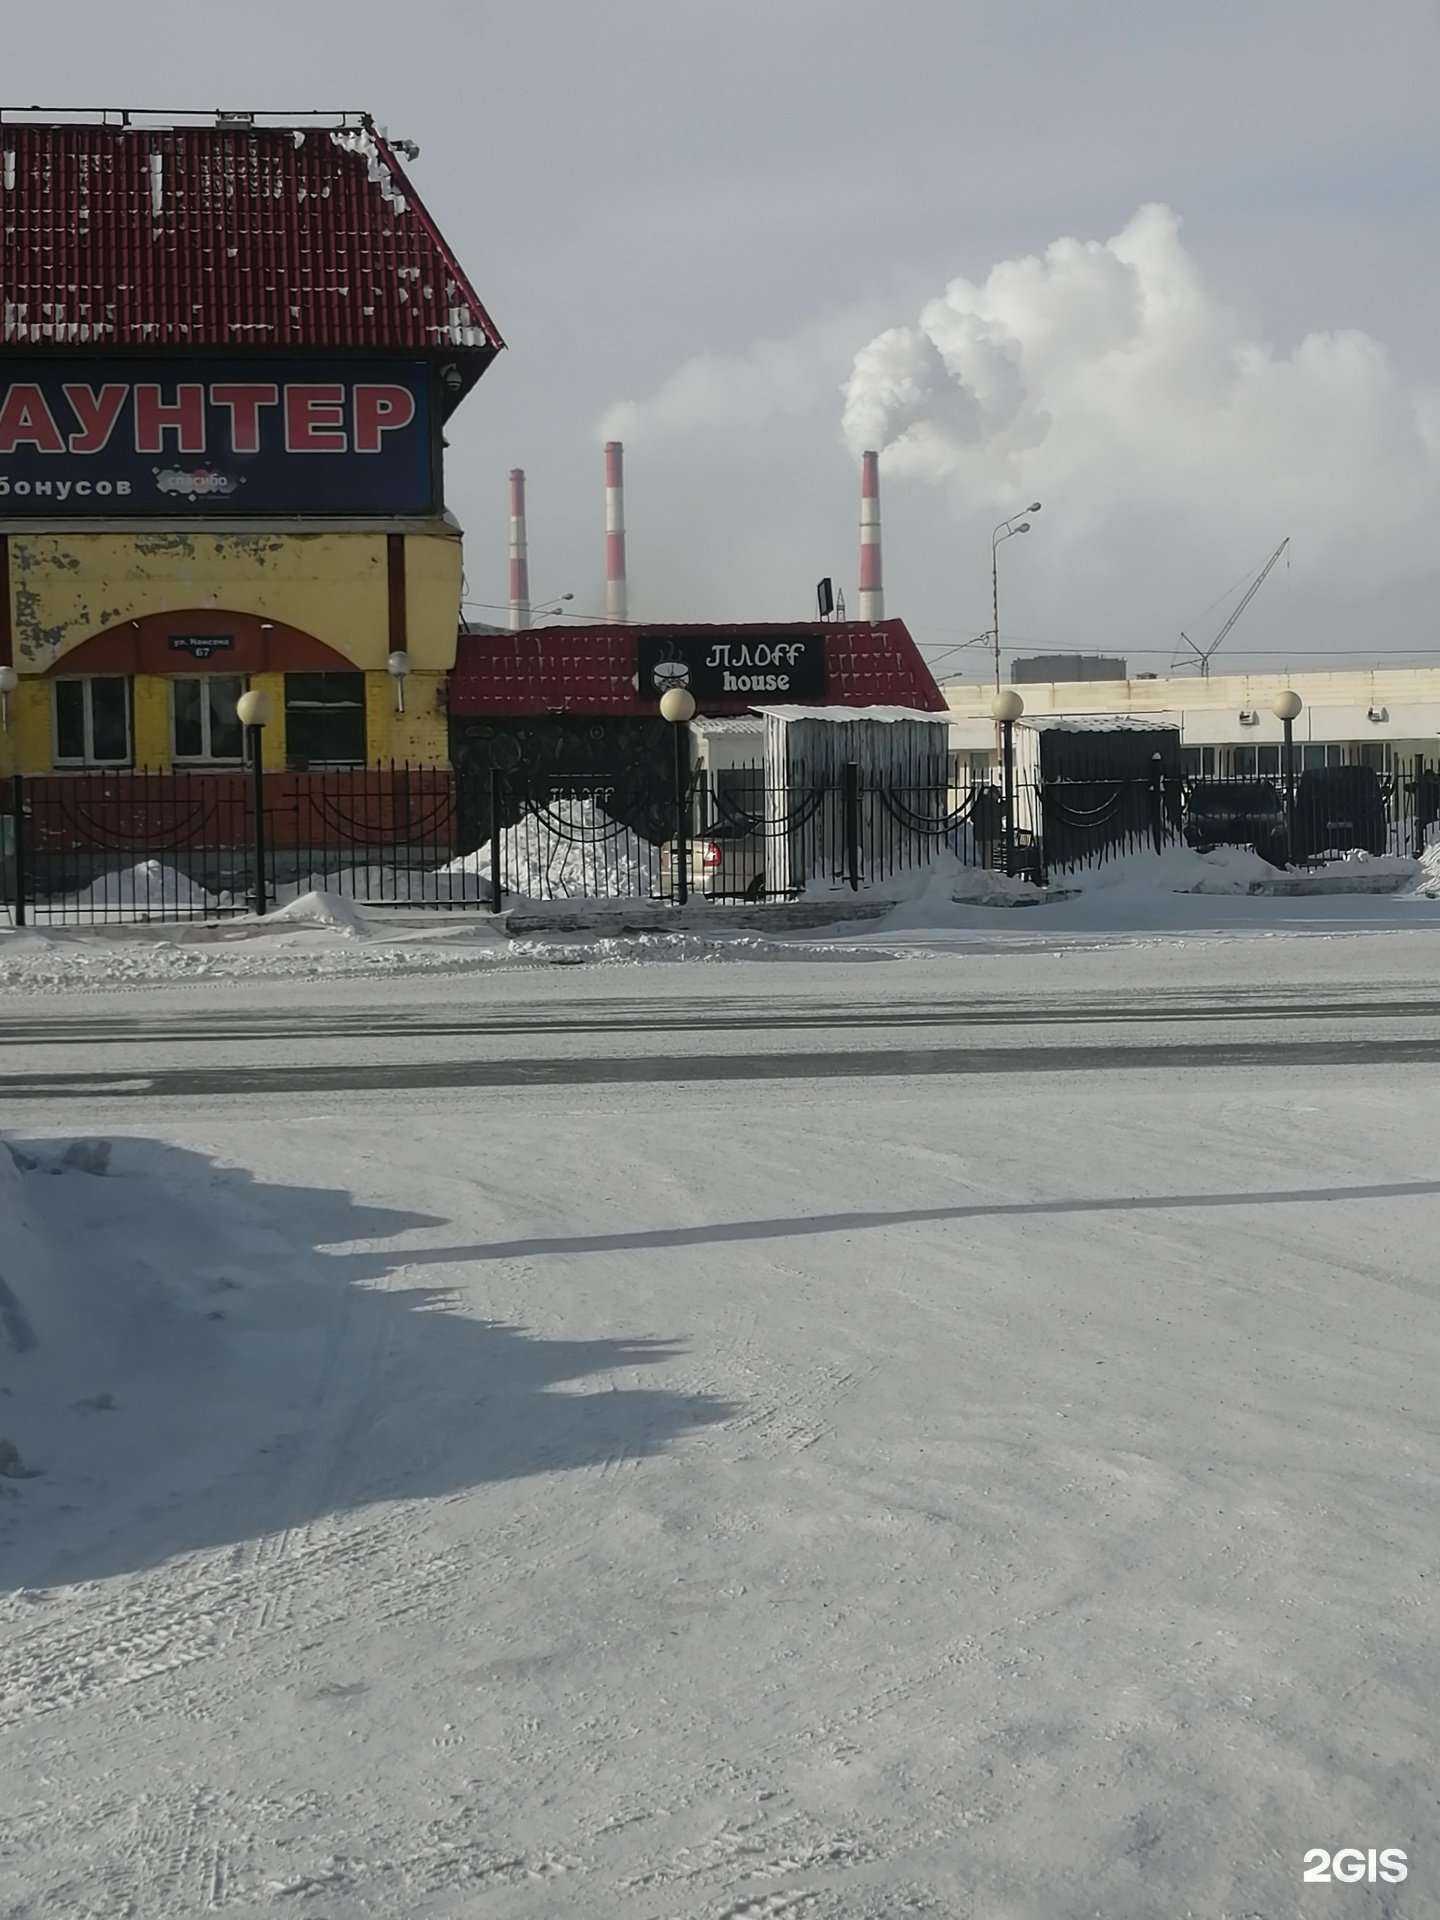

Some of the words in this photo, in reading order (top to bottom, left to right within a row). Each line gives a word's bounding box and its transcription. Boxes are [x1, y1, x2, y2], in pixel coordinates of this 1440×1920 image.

[0, 383, 416, 454] АУНТЕР
[0, 476, 132, 501] бонусов
[195, 647, 210, 657] 67
[723, 671, 790, 691] house
